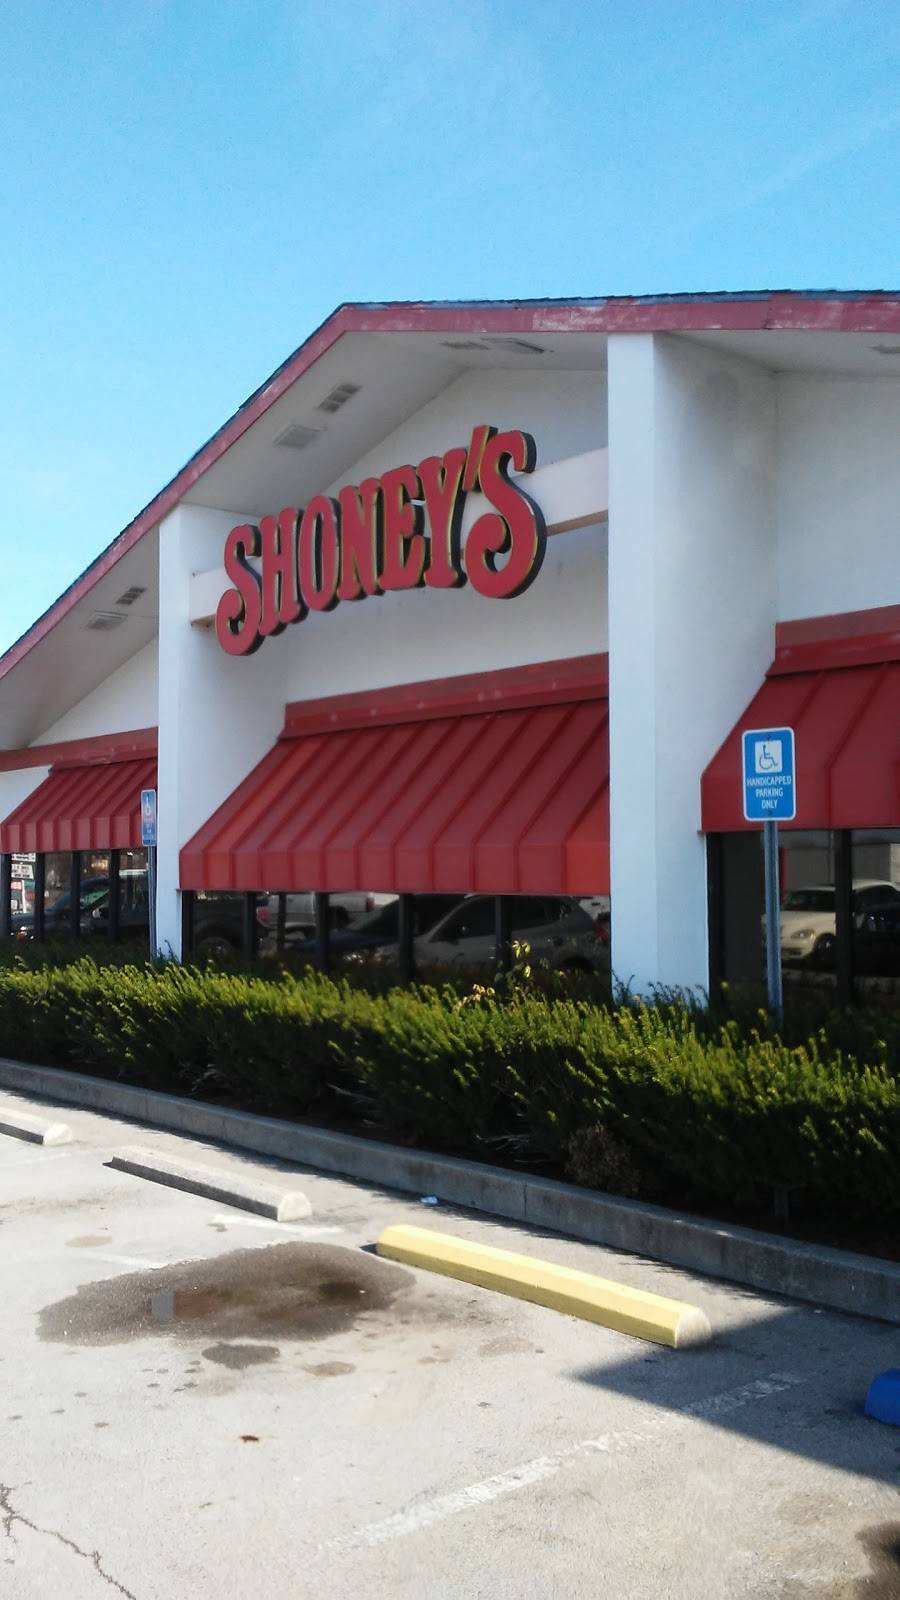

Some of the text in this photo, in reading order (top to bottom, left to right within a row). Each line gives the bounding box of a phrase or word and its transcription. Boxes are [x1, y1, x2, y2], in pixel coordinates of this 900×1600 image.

[215, 424, 546, 656] SHONEY'S
[746, 775, 792, 786] HANDICAPPED
[755, 787, 784, 798] PARKING
[761, 799, 778, 809] ONLY
